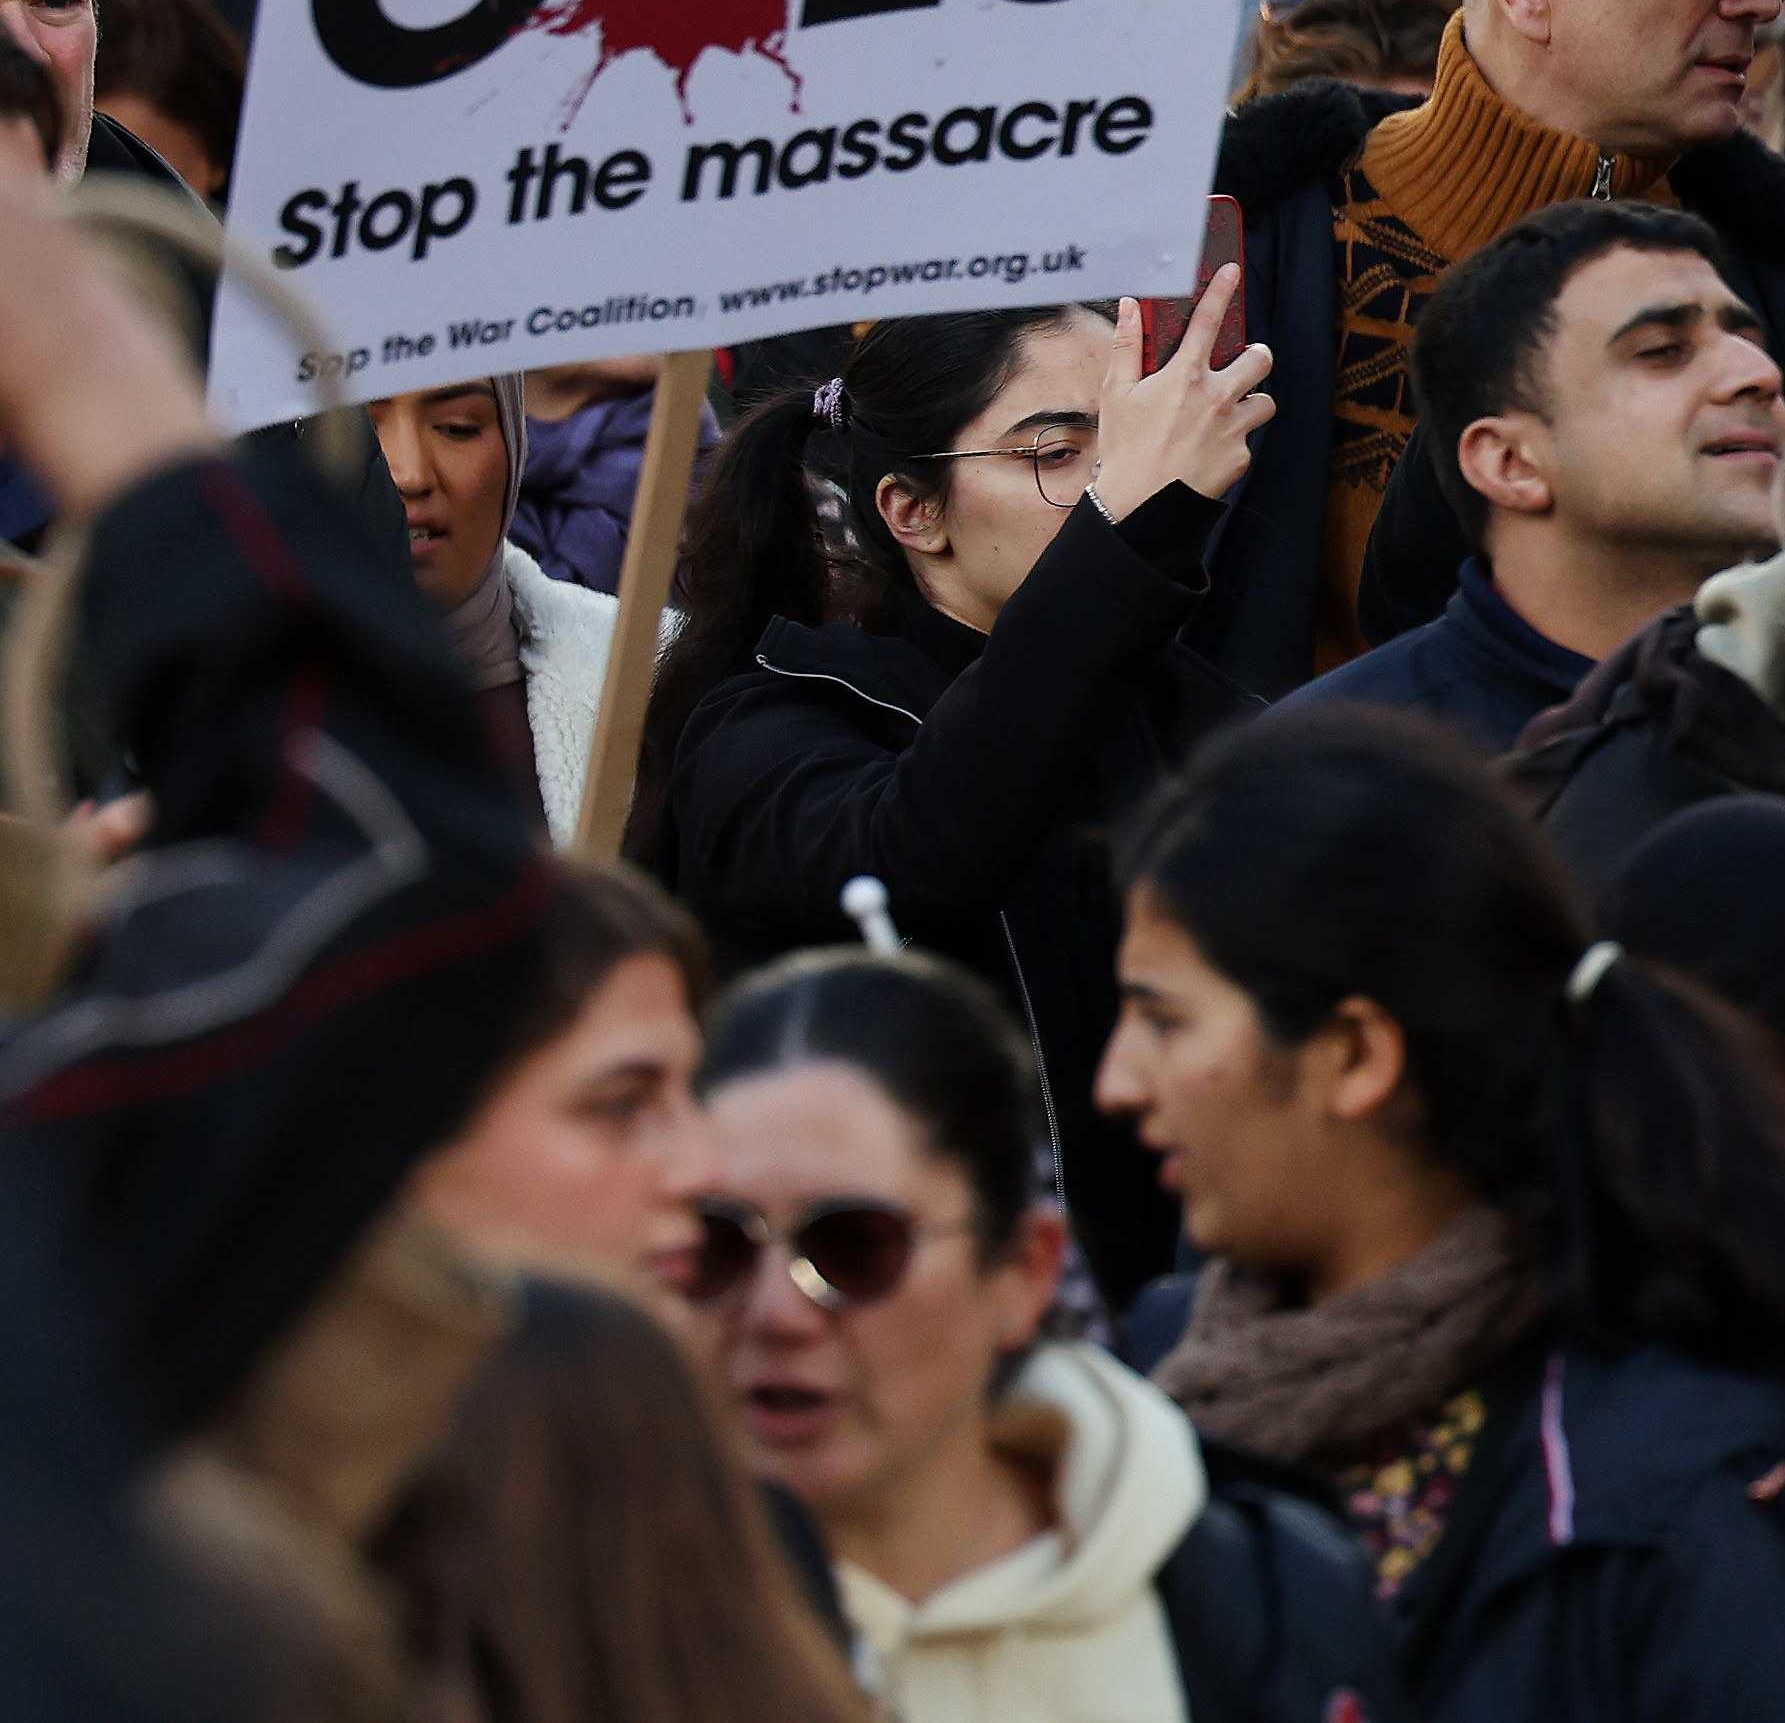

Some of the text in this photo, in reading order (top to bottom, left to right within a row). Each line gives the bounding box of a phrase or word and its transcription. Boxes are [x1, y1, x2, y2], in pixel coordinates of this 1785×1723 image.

[272, 96, 1154, 270] Stop the massacre
[296, 245, 1089, 382] Sop the War Coalition www.stopwar.org.uk
